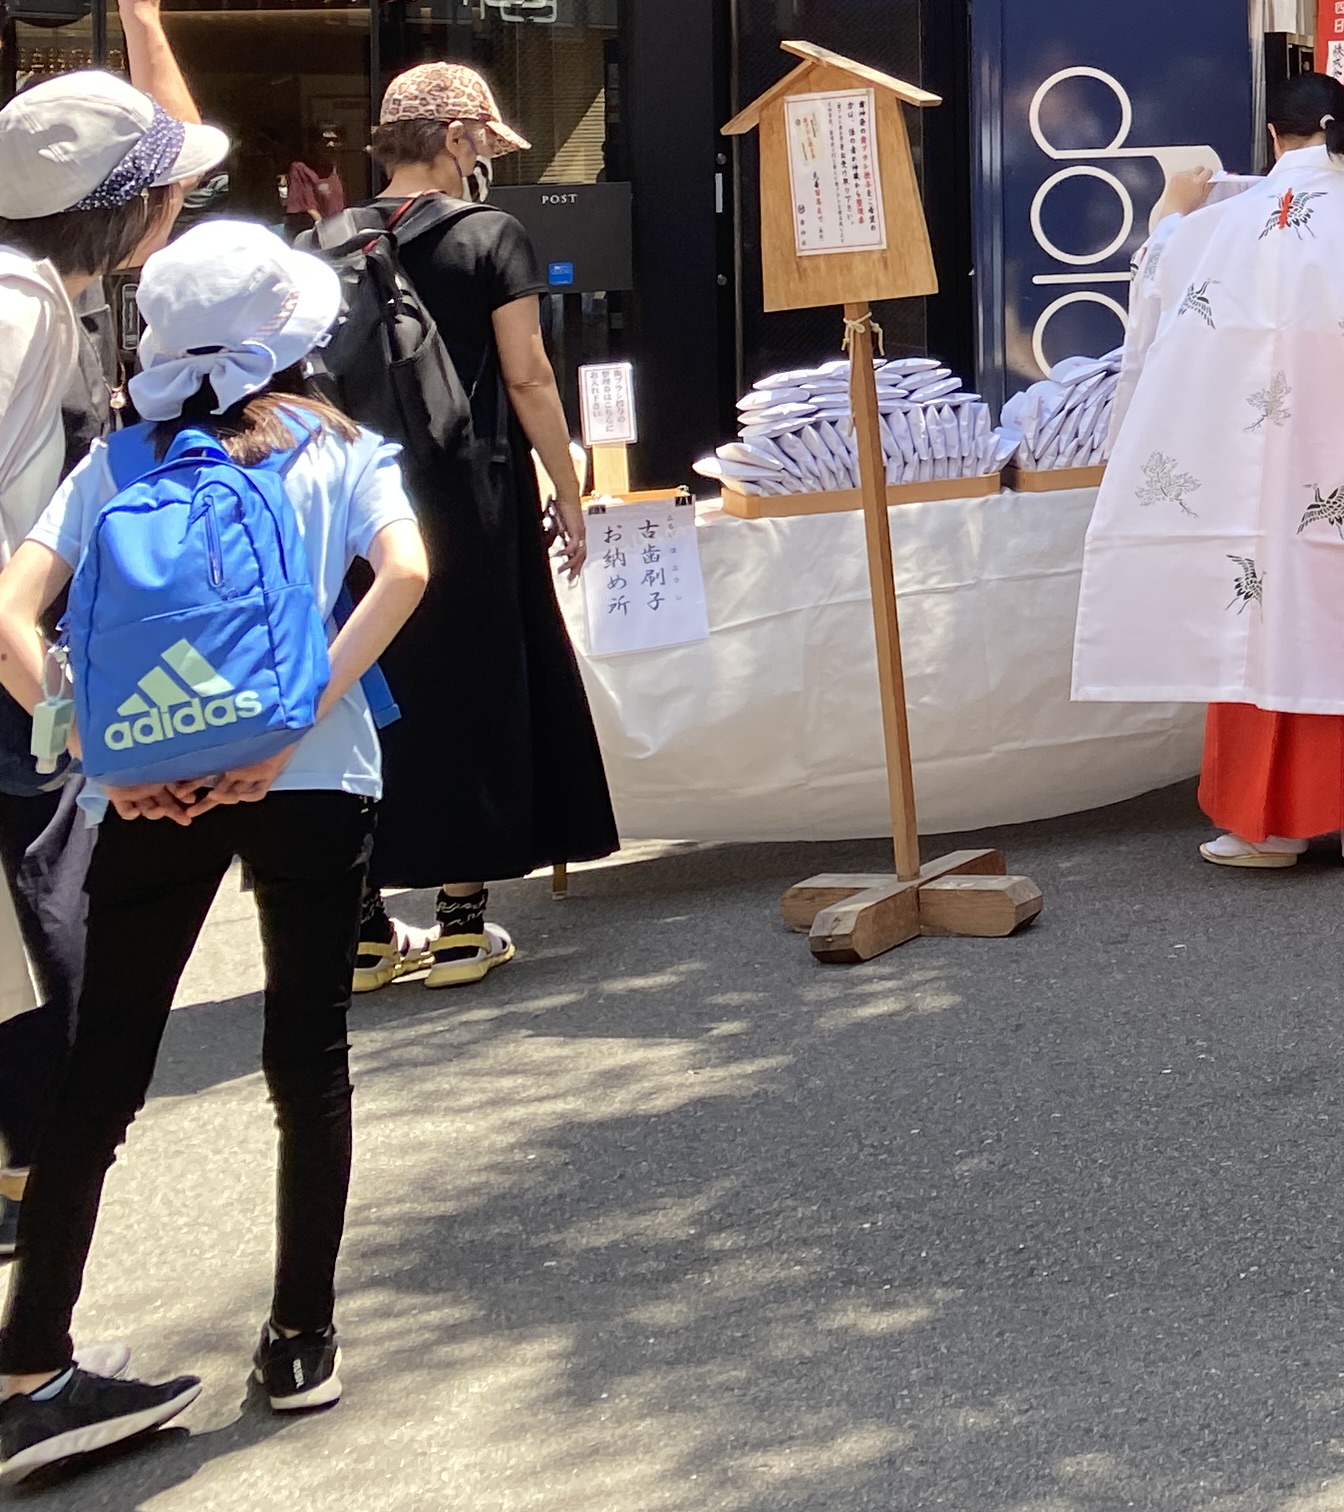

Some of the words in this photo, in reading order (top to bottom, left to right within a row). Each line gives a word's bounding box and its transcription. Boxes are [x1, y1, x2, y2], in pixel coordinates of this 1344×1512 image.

[541, 193, 578, 205] POST
[602, 523, 632, 617] お納め所
[637, 519, 666, 613] 古歯刷子
[104, 687, 263, 752] adidas
